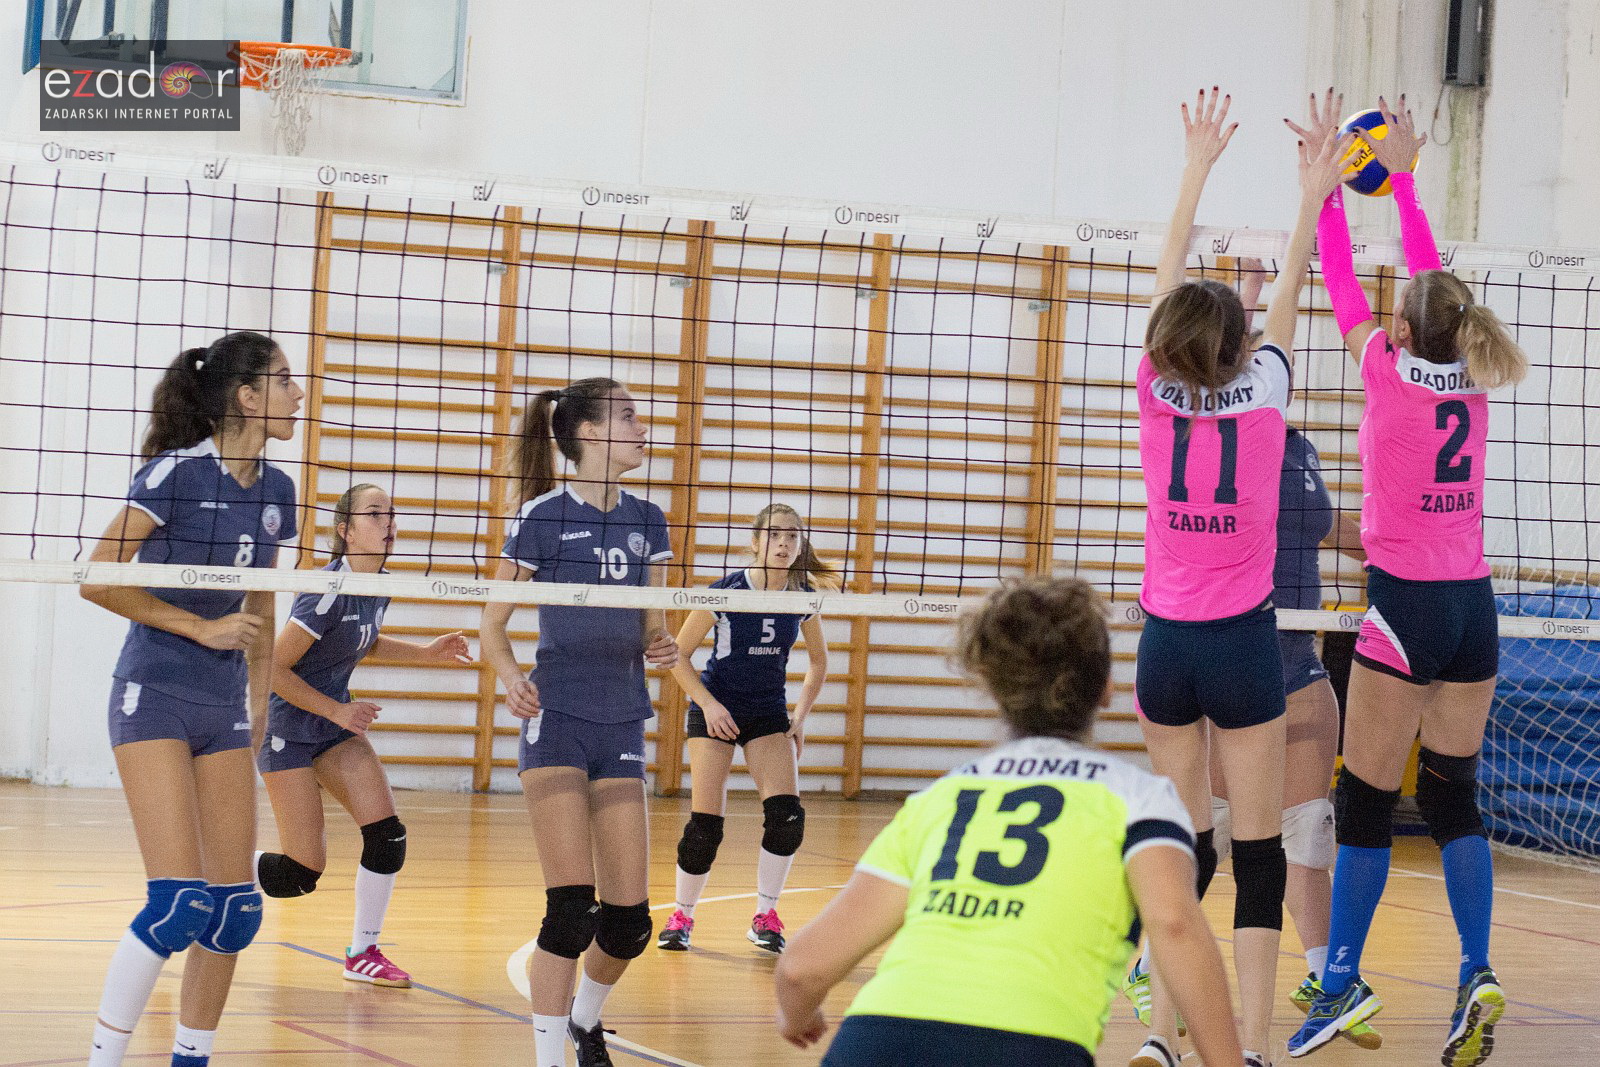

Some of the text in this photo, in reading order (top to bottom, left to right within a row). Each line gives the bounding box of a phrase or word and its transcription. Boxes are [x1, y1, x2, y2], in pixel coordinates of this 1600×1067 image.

[339, 171, 389, 185] INDESIT
[603, 191, 650, 205] INDESIT
[855, 210, 900, 224] INDESIT
[1095, 228, 1139, 241] INDESIT
[1545, 255, 1586, 267] INDESIT
[1434, 400, 1472, 484] 2
[1168, 416, 1238, 504] 11
[1421, 492, 1475, 513] ZADAR
[1168, 511, 1237, 534] ZADAR
[234, 534, 255, 567] 8
[593, 547, 628, 580] 10
[450, 585, 490, 596] INDESIT
[690, 595, 729, 605] INDESIT
[921, 603, 958, 613] INDESIT
[760, 619, 776, 644] 5
[748, 646, 781, 655] BIBINJE
[993, 757, 1108, 780] DONAT
[930, 785, 1065, 886] 13
[922, 889, 1025, 919] ZADAR
[1328, 962, 1351, 974] ZEUS
